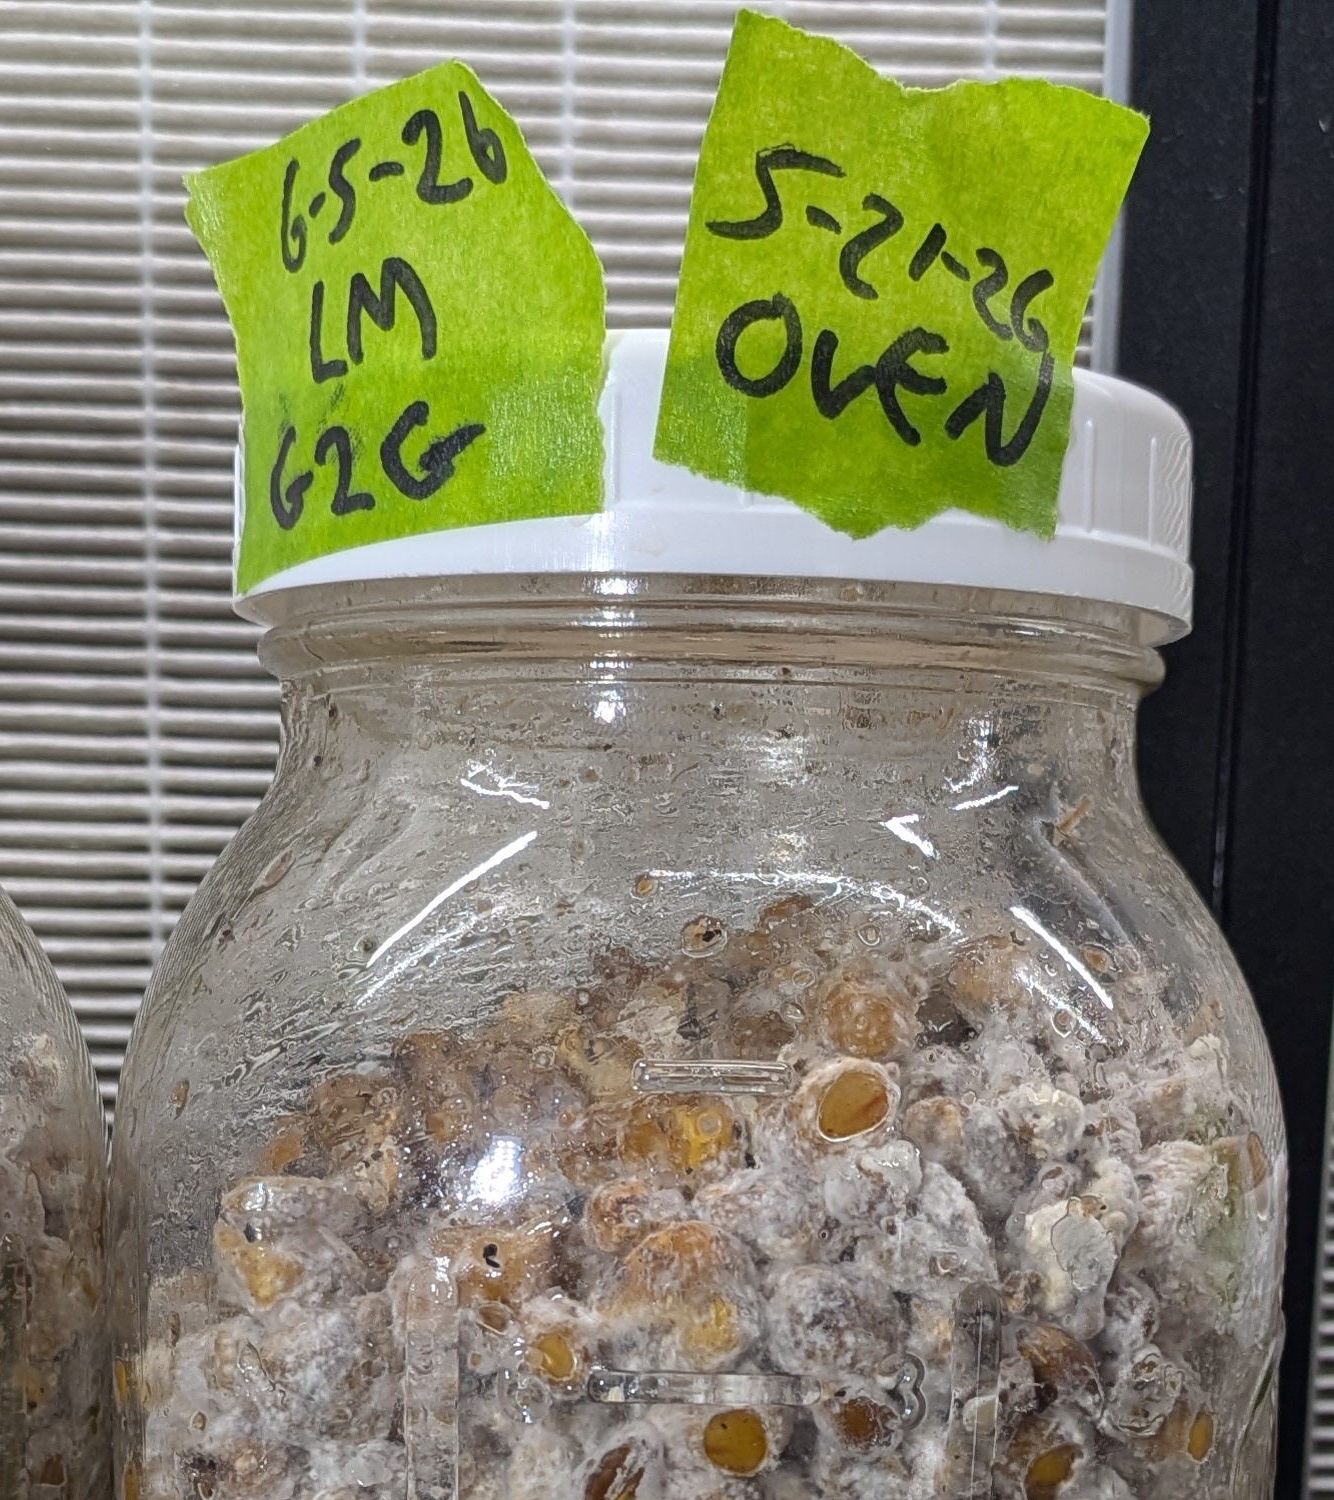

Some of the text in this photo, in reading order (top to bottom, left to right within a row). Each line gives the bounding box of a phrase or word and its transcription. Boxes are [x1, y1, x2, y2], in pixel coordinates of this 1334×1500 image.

[279, 90, 509, 274] 6-5-26
[703, 142, 1055, 354] 5-21-26
[307, 255, 442, 385] LM
[712, 290, 1057, 470] OVEN
[267, 398, 489, 532] G2G
